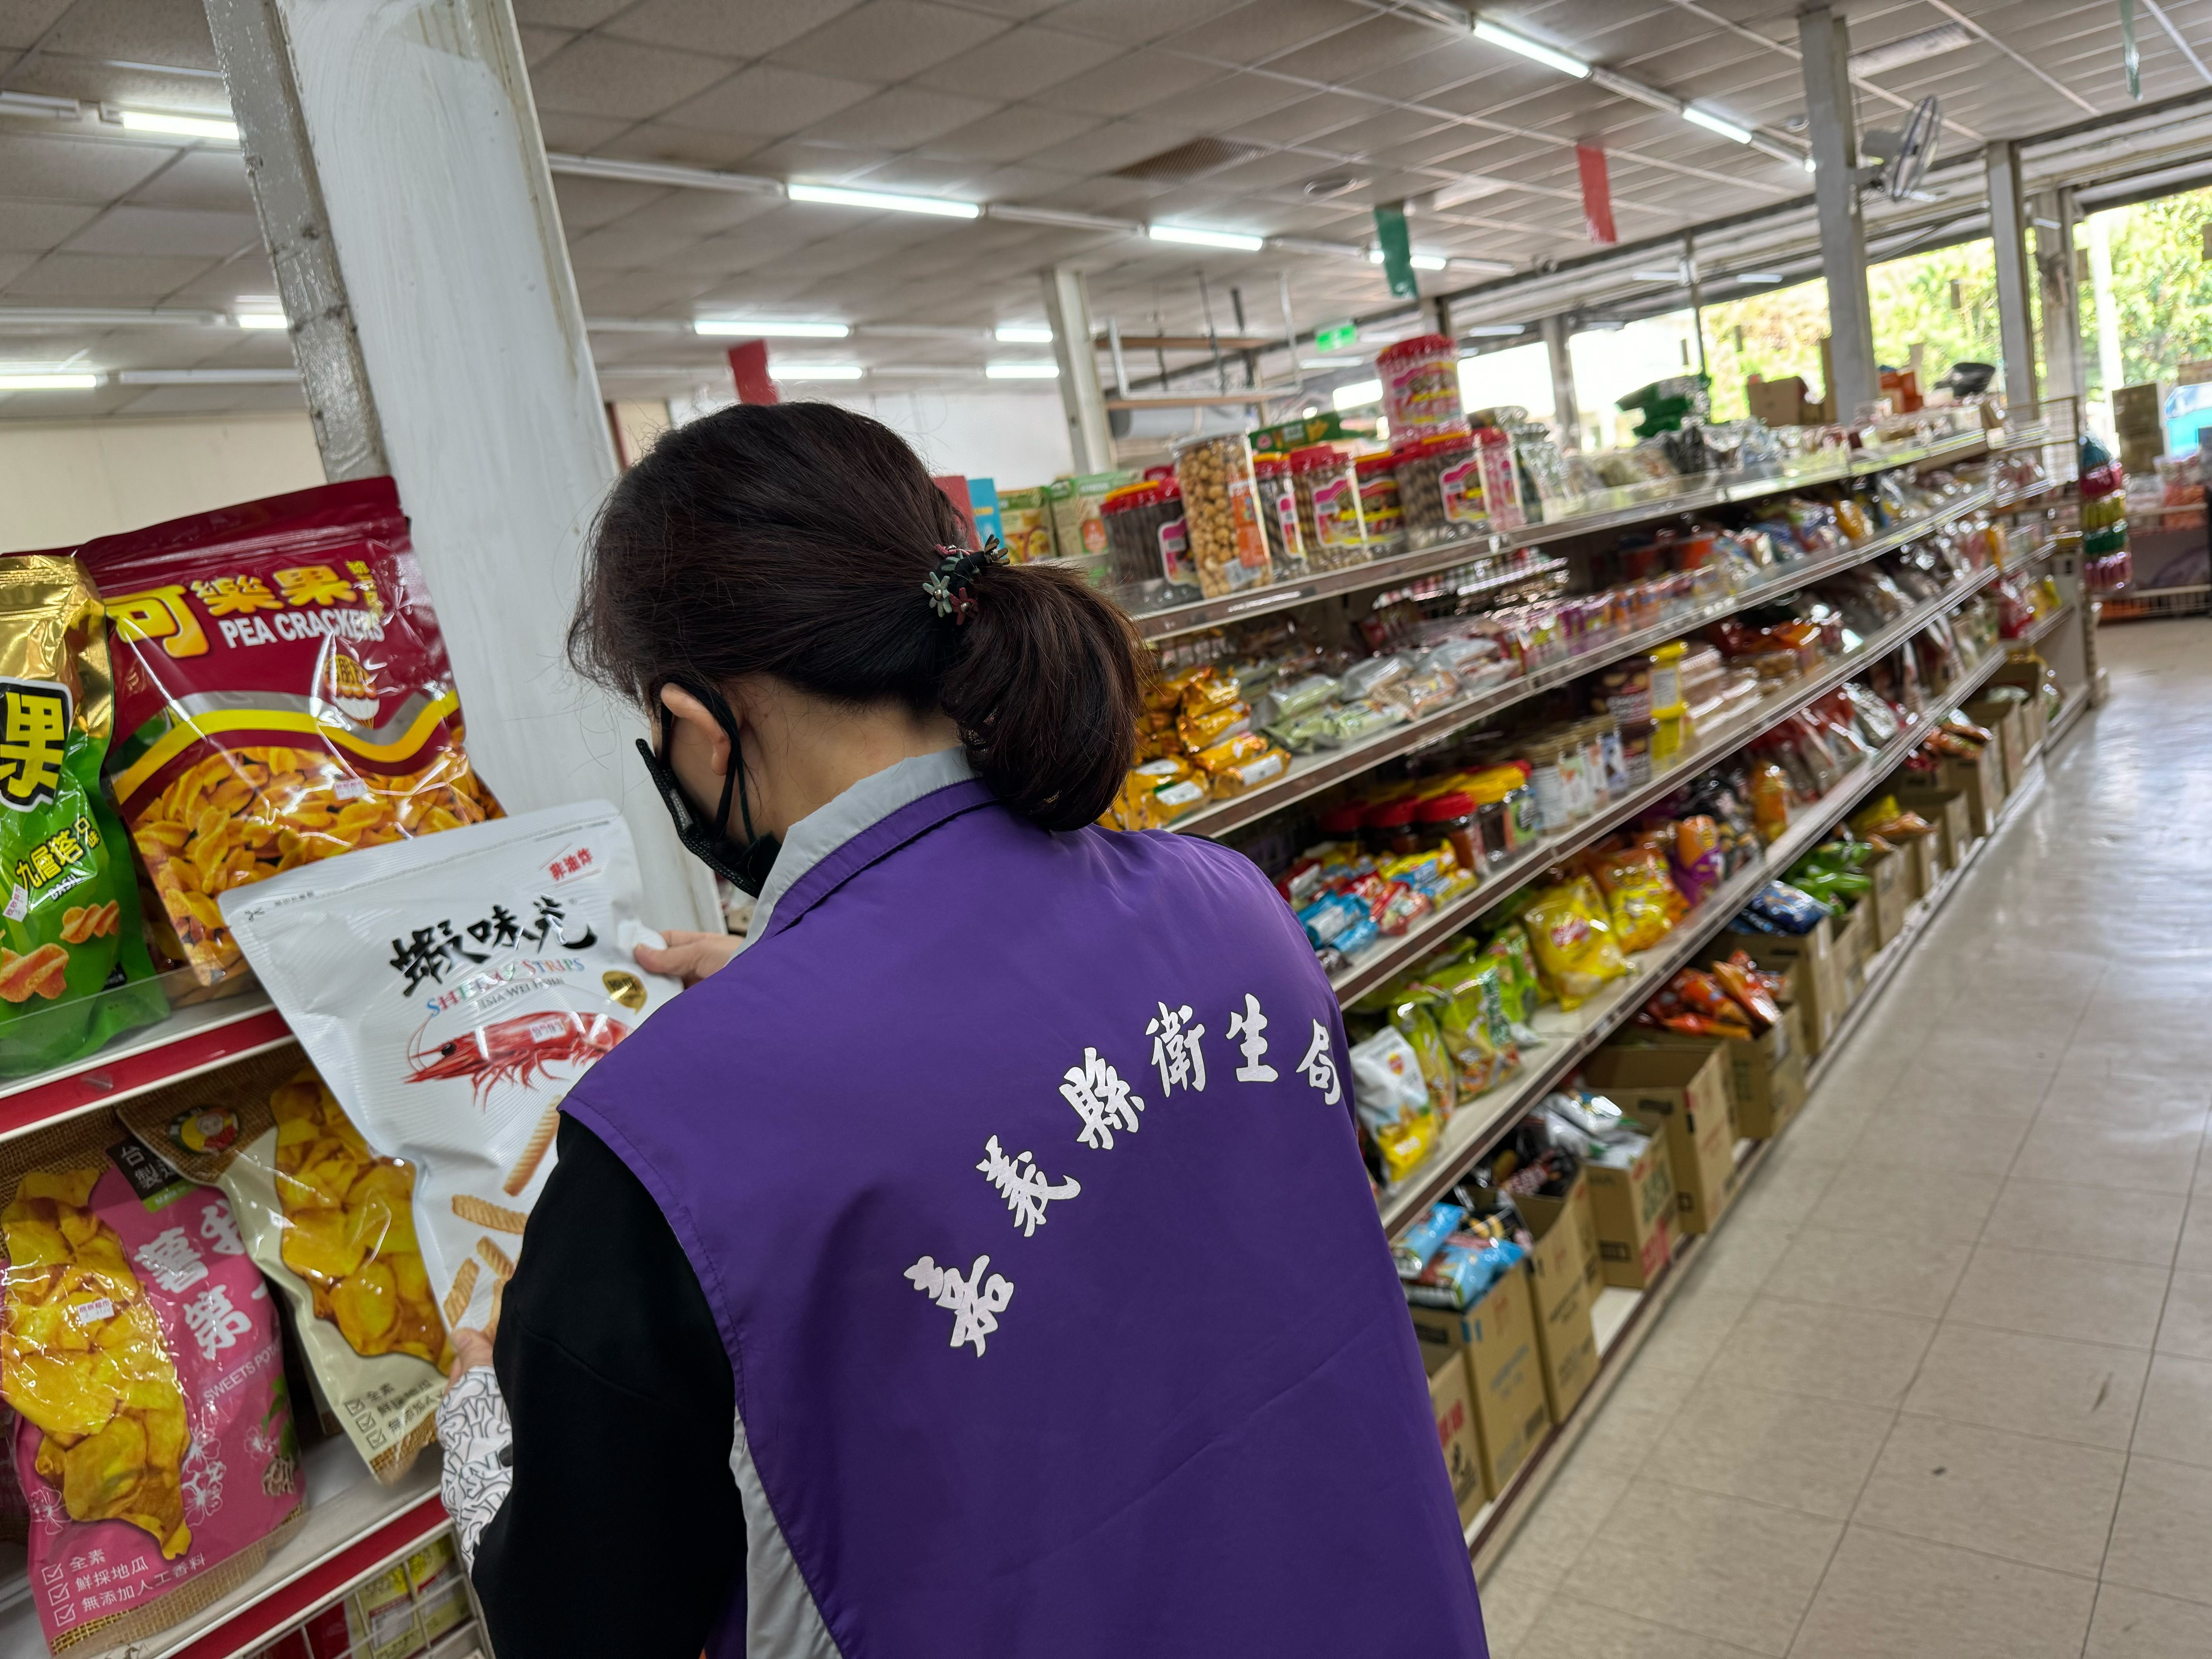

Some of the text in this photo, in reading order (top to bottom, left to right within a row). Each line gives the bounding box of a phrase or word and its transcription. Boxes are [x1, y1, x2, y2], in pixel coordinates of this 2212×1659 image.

[102, 564, 358, 659] 可樂果
[218, 608, 385, 649] PEA CRACKERS
[74, 816, 100, 849] 口味
[16, 829, 84, 891] 九層塔
[549, 847, 593, 881] 非油炸
[520, 957, 585, 976] STRIPS
[903, 993, 1341, 1358] 嘉義縣衛生局
[203, 1361, 256, 1402] SWEETS
[69, 1549, 106, 1573] 全素
[76, 1555, 149, 1592] 鮮採地瓜
[81, 1552, 206, 1612] 無添加人工香料
